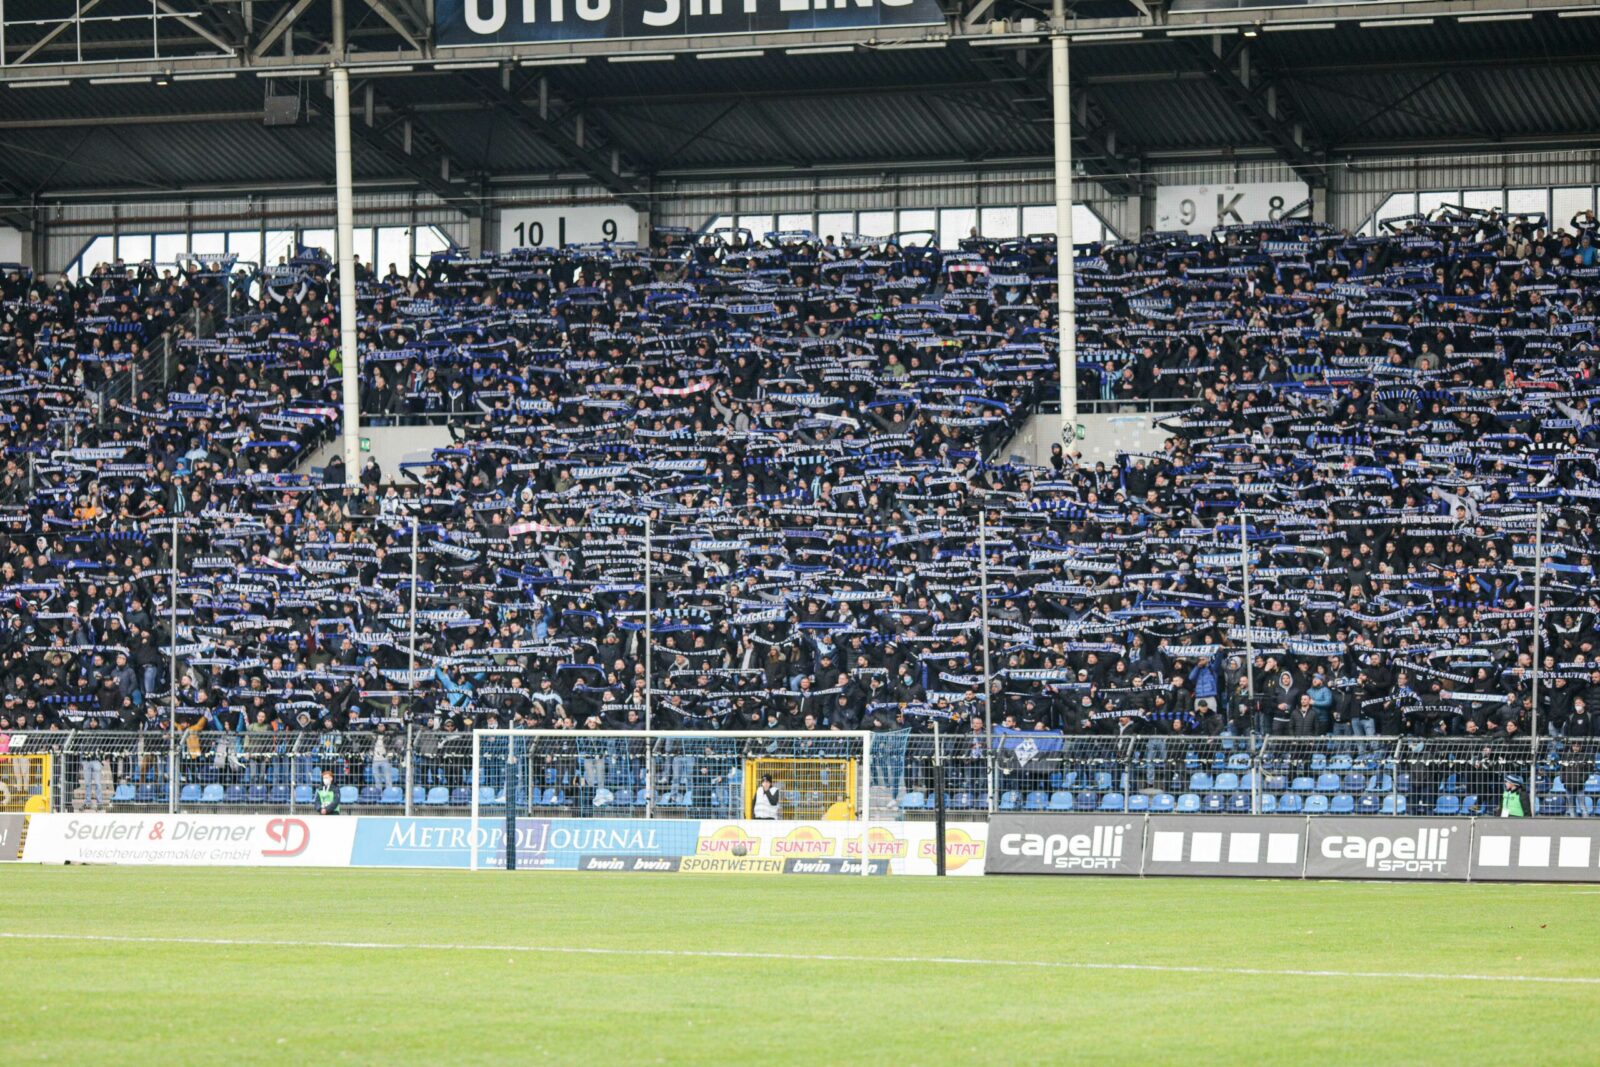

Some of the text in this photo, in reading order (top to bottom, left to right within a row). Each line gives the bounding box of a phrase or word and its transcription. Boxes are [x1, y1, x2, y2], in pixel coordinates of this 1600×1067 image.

[1179, 193, 1285, 226] 9 K 8
[513, 221, 544, 246] 10
[602, 219, 618, 243] 9
[64, 820, 255, 841] Seufert & Diemer
[261, 818, 311, 857] SD
[700, 840, 756, 852] SUNTAT
[775, 841, 831, 853] SUNTAT
[1000, 825, 1124, 865] capelli
[1321, 828, 1450, 867] capelli
[79, 847, 251, 861] Versicherungsmakler GmbH
[587, 857, 625, 870] bwin
[633, 858, 671, 871] bwin
[683, 858, 782, 872] SPORTWETTEN
[792, 860, 831, 873] bwin
[840, 861, 878, 873] bwn
[1055, 857, 1121, 869] SPORT
[1378, 860, 1447, 872] SPORT
